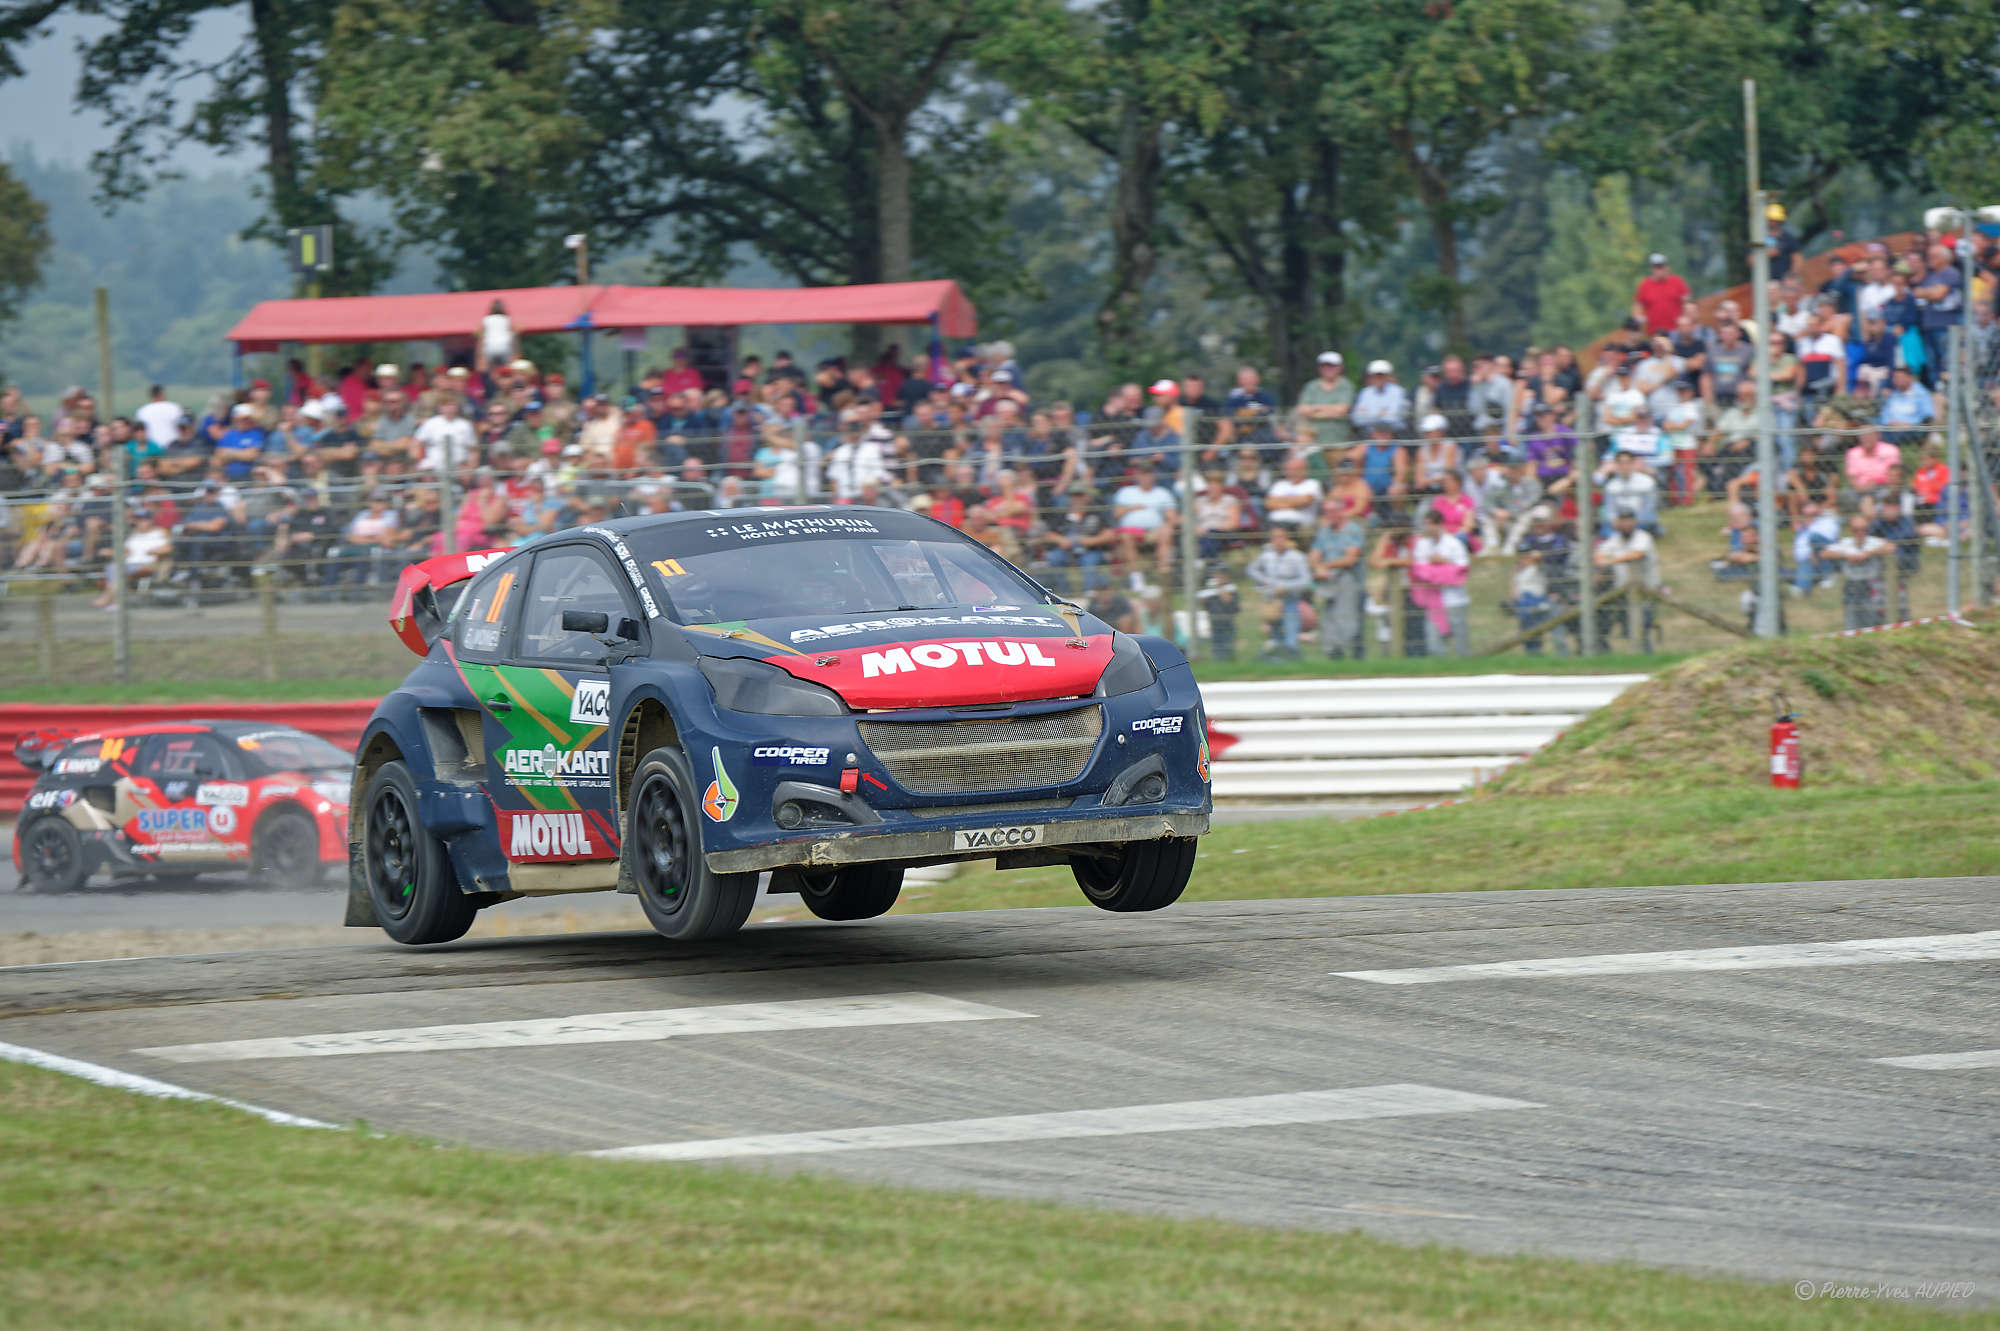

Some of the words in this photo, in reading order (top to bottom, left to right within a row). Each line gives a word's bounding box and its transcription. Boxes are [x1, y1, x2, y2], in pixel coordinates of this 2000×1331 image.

[732, 523, 755, 534] LE
[762, 518, 873, 530] MATHURIN
[845, 526, 880, 534] PARIS
[650, 558, 688, 577] 11
[486, 573, 515, 623] 11
[861, 641, 1056, 679] MOTUL
[1132, 716, 1183, 731] COOPER
[1152, 726, 1181, 735] TIRES
[753, 747, 830, 758] COOPER
[789, 757, 828, 765] TIRES
[29, 790, 60, 809] elf
[138, 808, 208, 831] SUPER
[511, 814, 593, 857] MOTUL
[963, 827, 1037, 848] YACCO
